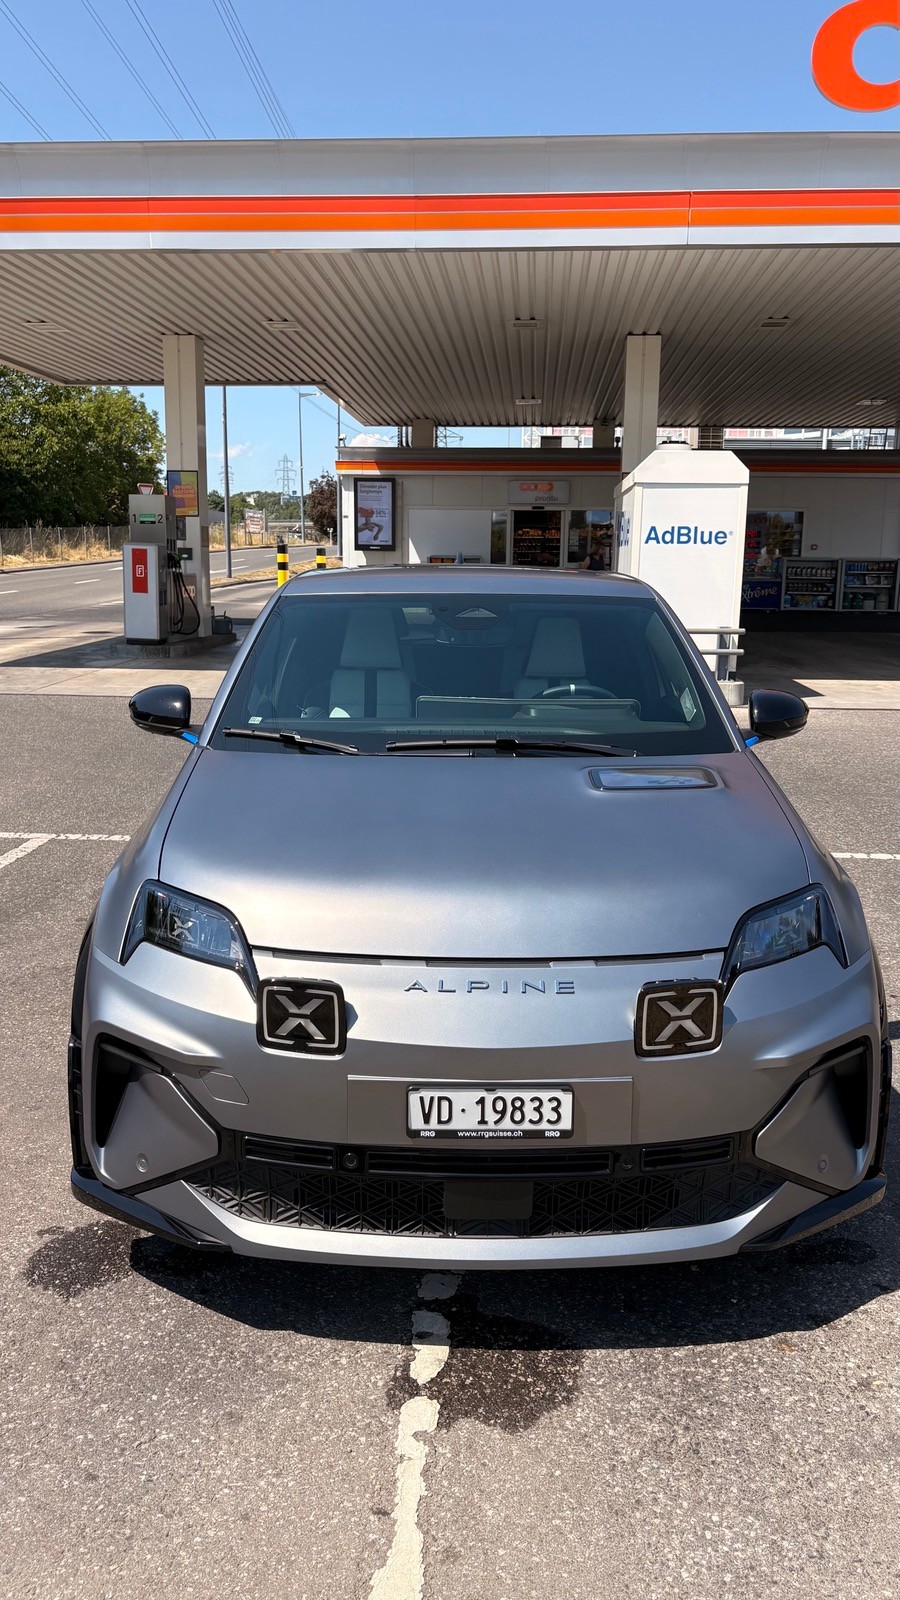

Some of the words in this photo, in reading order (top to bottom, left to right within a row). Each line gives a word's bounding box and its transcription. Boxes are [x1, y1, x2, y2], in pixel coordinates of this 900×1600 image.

[132, 513, 137, 523] 1
[157, 513, 163, 523] 2
[741, 586, 778, 602] xtrême
[404, 980, 575, 994] ALPINE
[457, 1130, 523, 1138] www.rrgsuisse.ch
